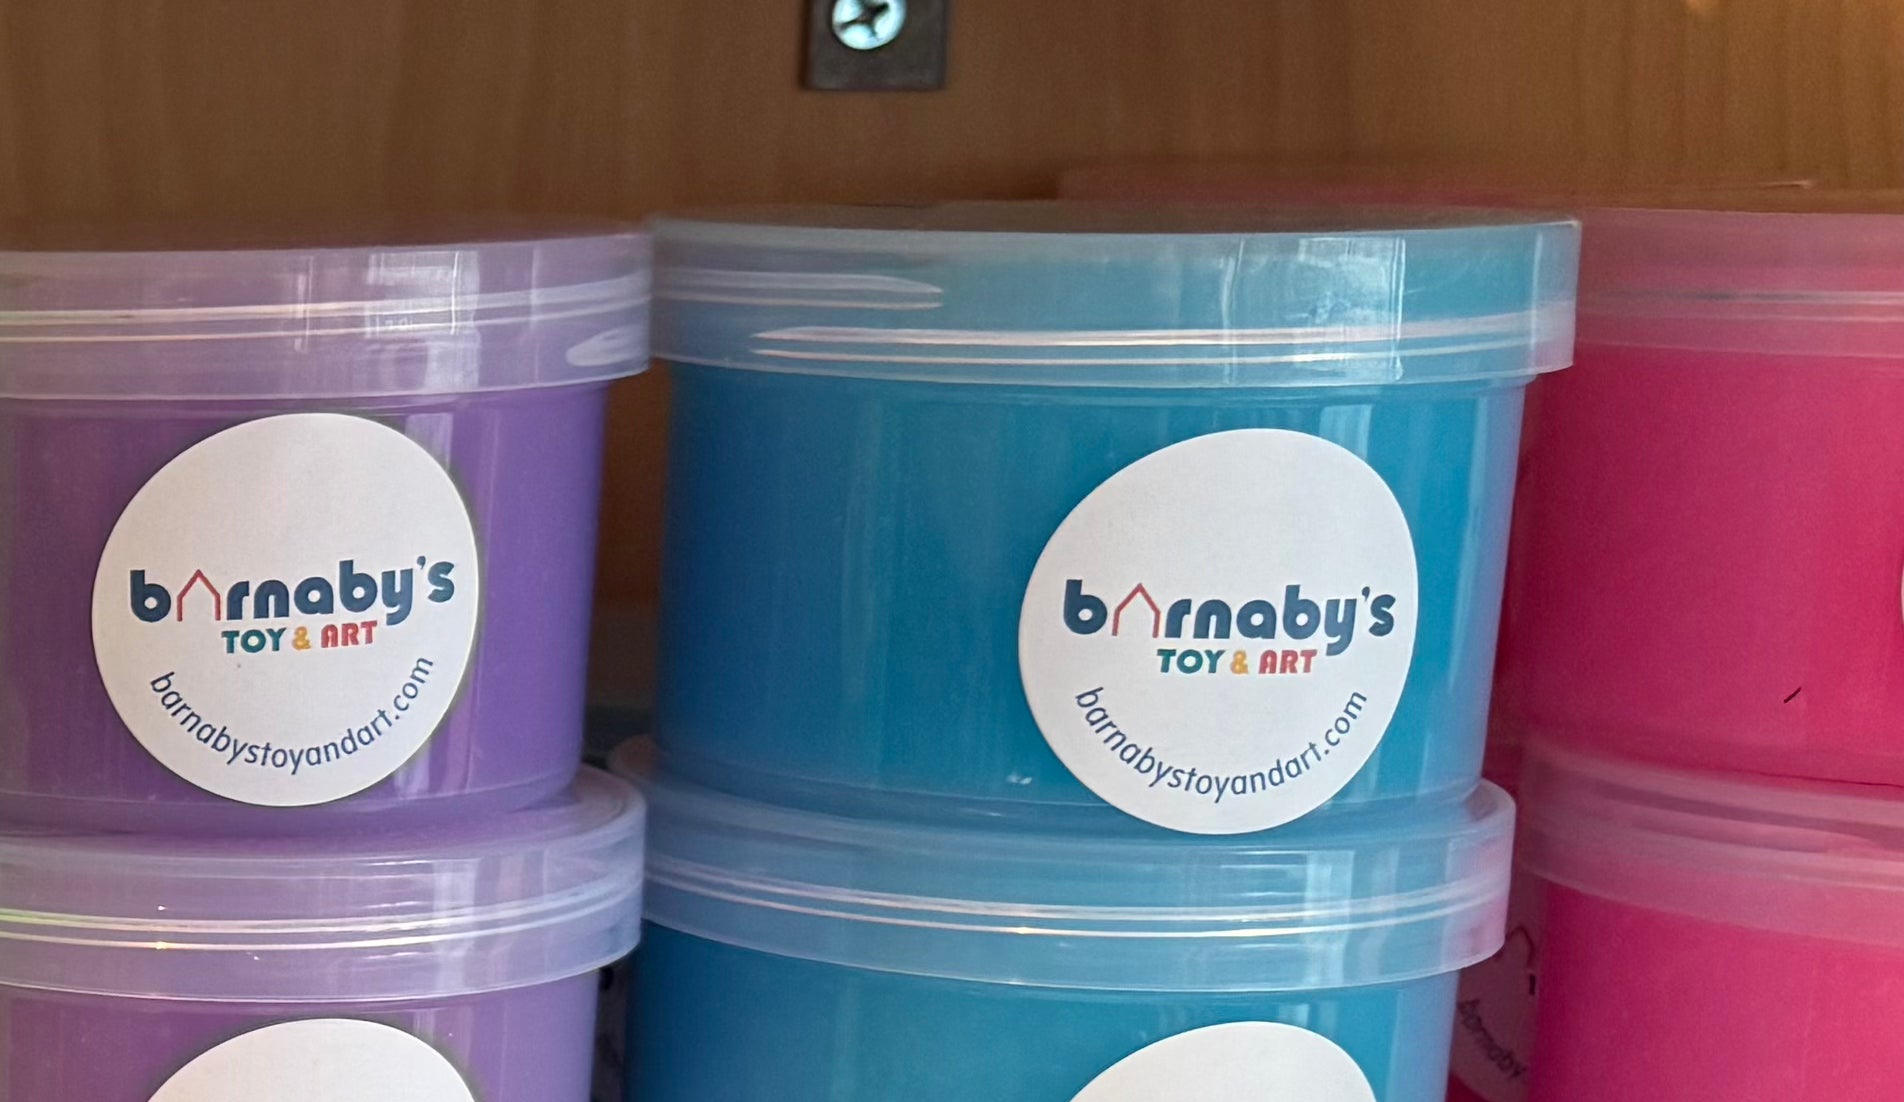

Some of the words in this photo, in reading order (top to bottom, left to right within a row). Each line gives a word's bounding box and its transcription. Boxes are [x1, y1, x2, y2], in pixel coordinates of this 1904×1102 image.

[221, 627, 288, 655] TOY
[292, 626, 312, 652] &
[319, 619, 379, 650] ART
[1154, 647, 1222, 676] TOY
[1226, 648, 1248, 674] &
[1254, 645, 1317, 674] ART
[148, 654, 436, 773] barnabystoyandart.com
[1074, 684, 1369, 804] barnabystoyandart.com
